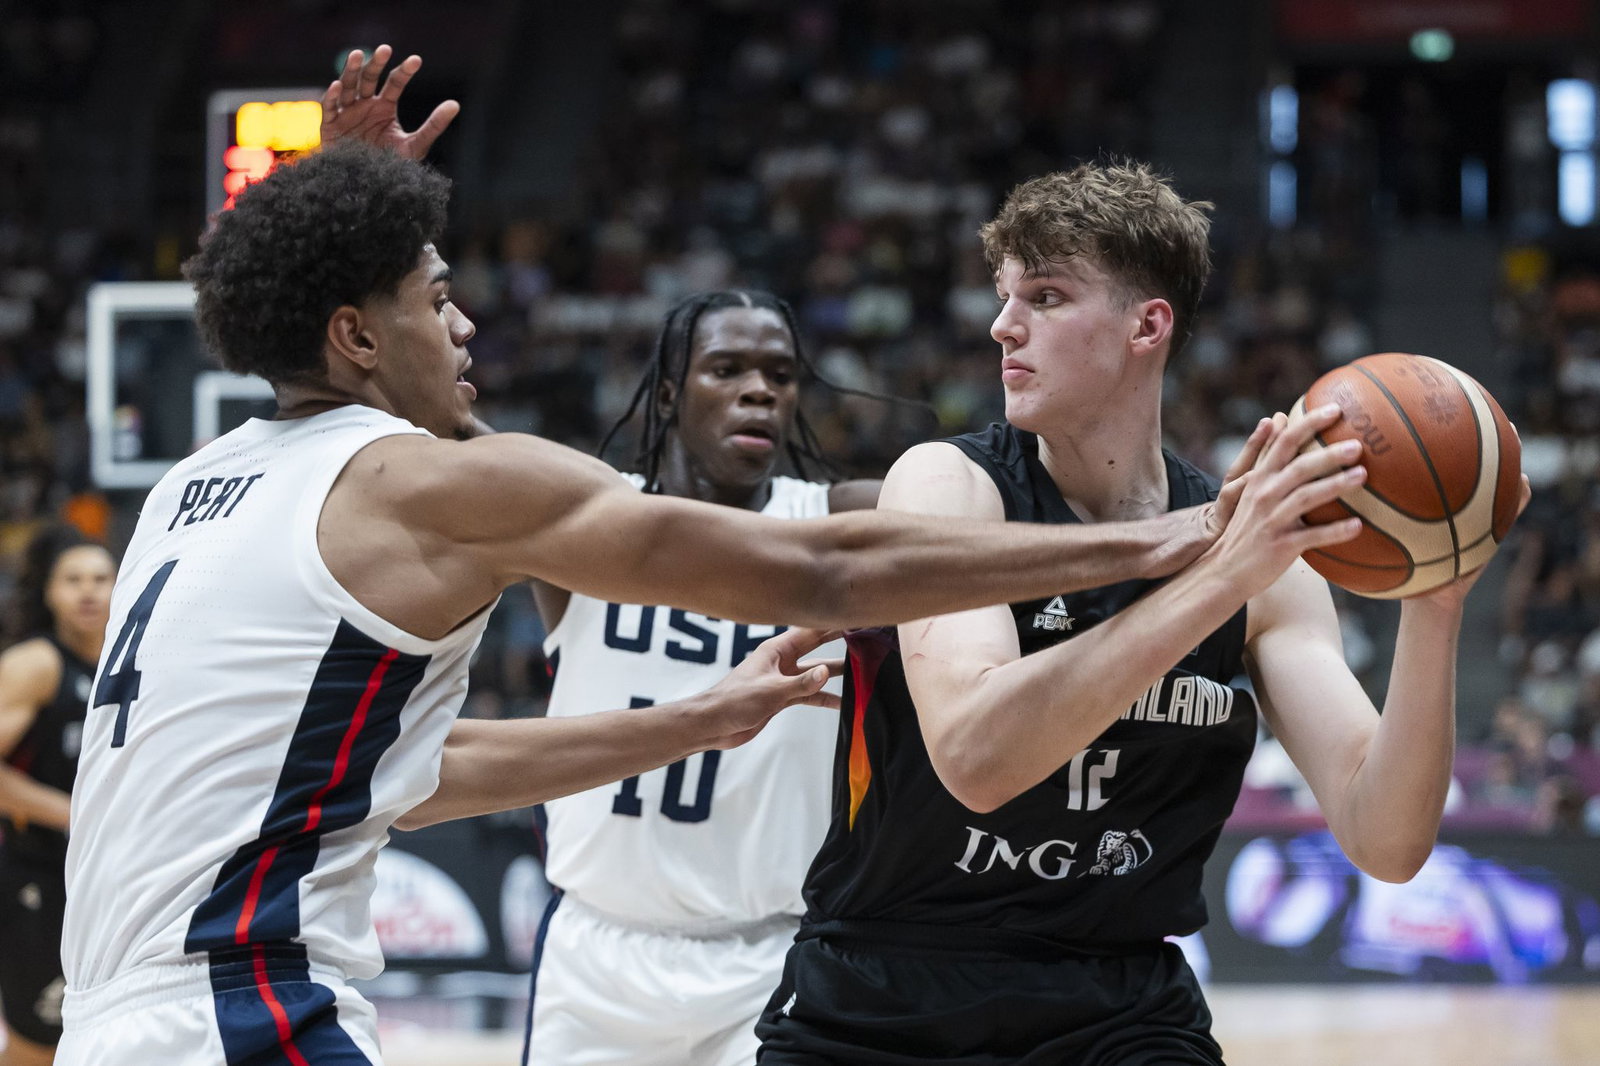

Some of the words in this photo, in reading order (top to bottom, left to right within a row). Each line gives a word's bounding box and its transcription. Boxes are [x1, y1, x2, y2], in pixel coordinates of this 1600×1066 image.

[1032, 612, 1076, 631] PEAK
[93, 558, 180, 748] 4
[953, 825, 1078, 880] ING
